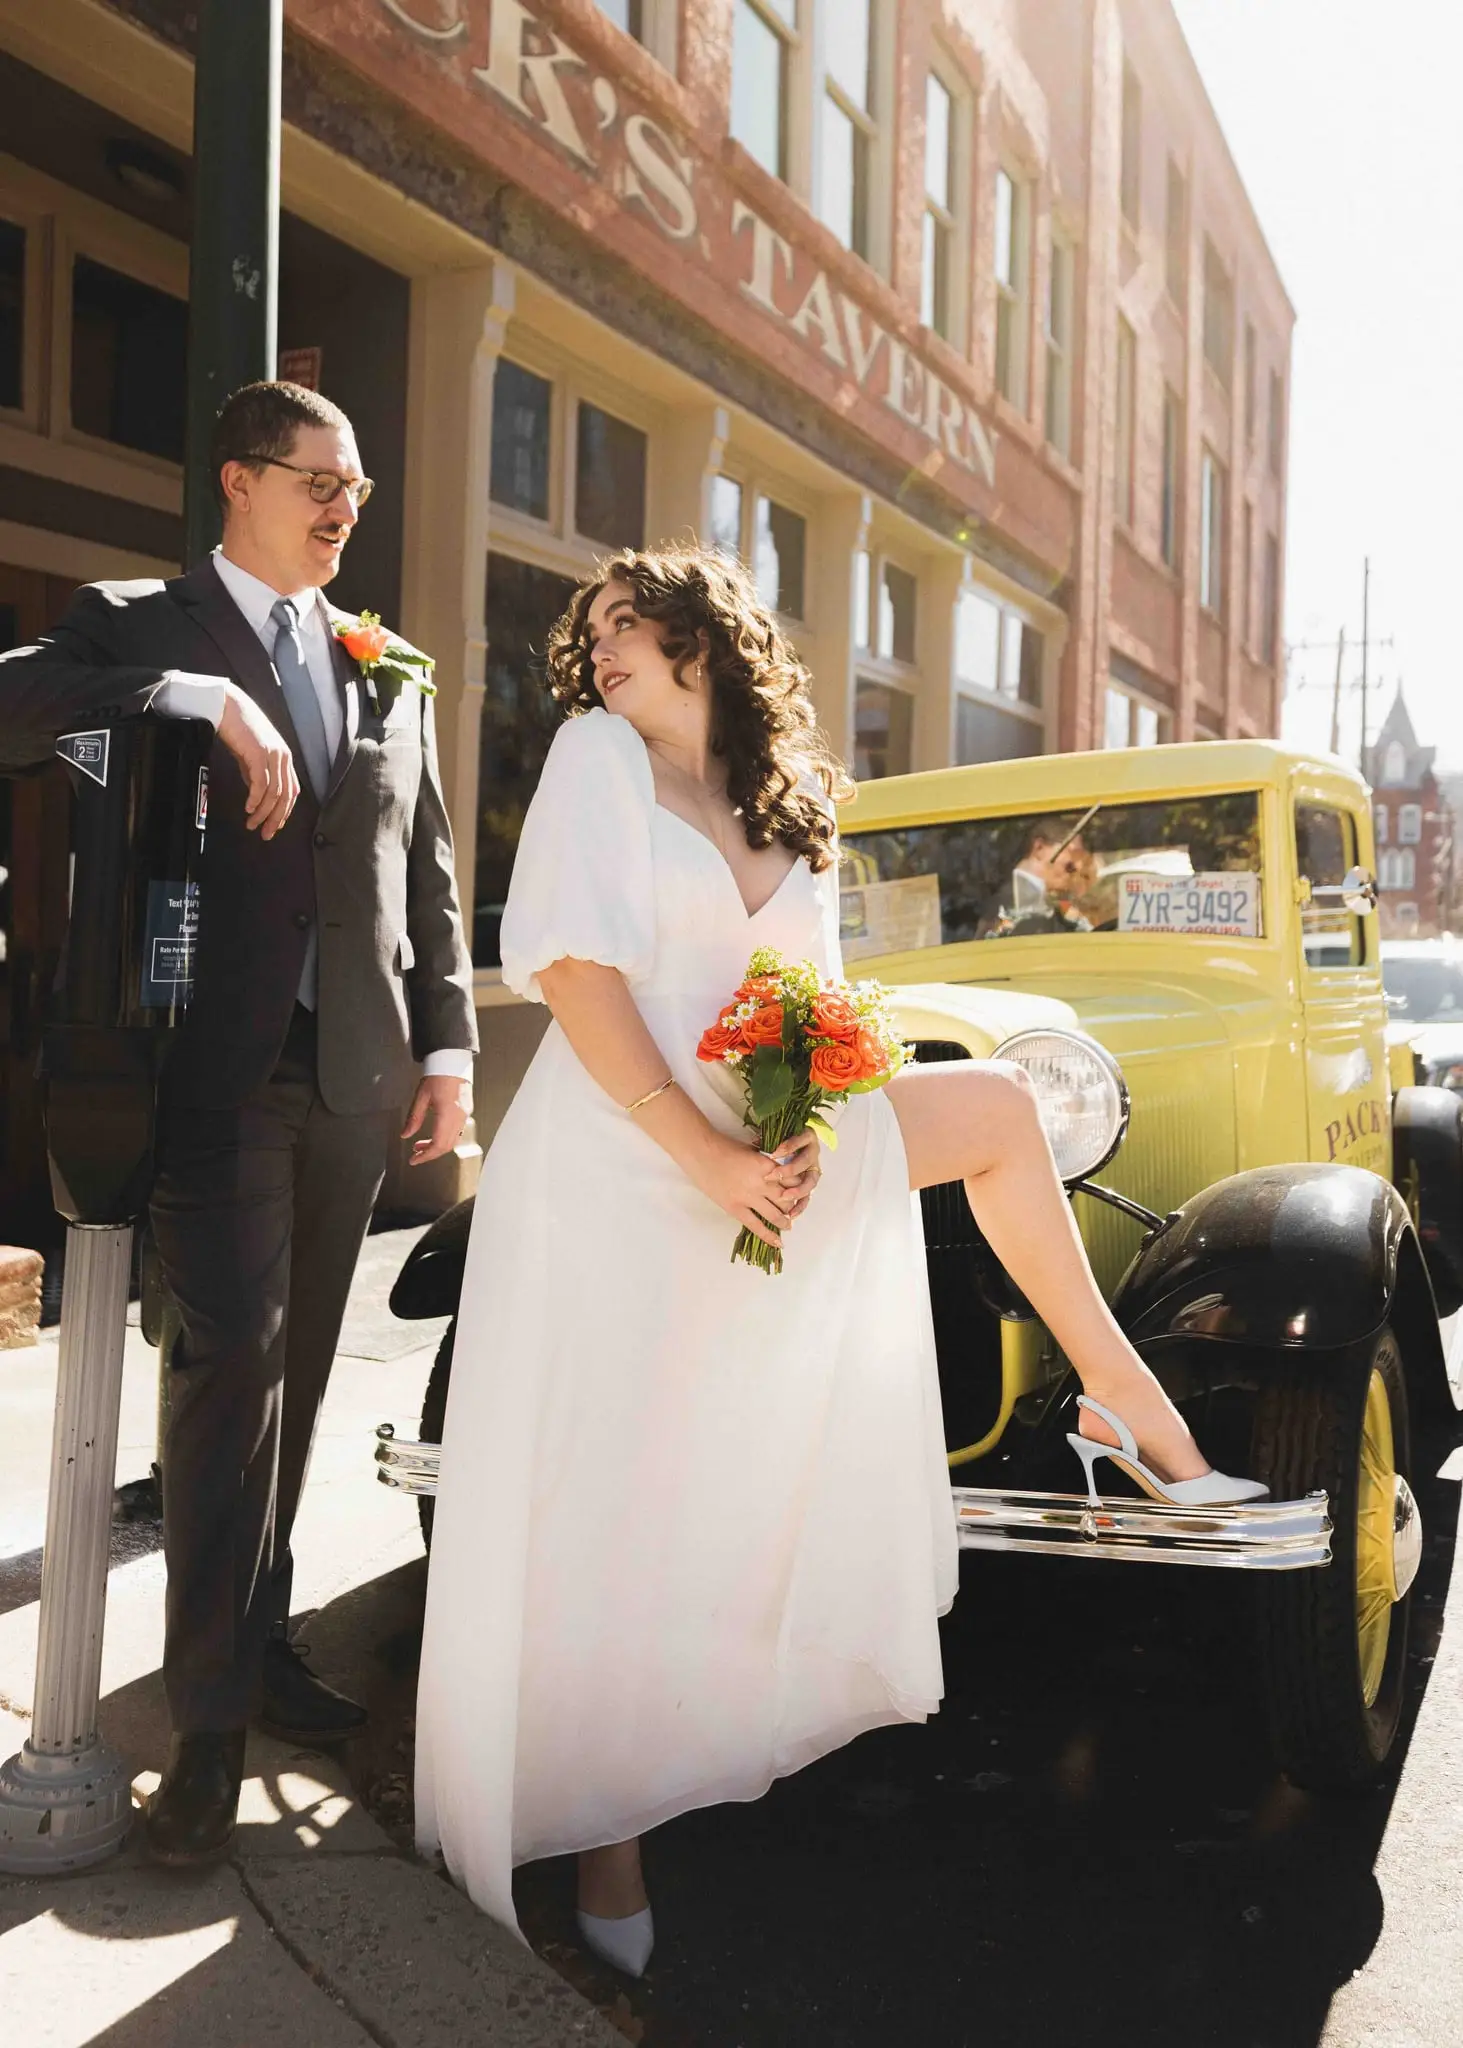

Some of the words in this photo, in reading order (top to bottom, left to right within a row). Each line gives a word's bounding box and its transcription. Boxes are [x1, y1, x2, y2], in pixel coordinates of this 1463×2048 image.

[379, 0, 698, 239] K'S
[730, 198, 1000, 489] TAVERN
[79, 746, 86, 759] 2
[168, 898, 183, 908] Text
[1126, 890, 1248, 924] ZYR-9492
